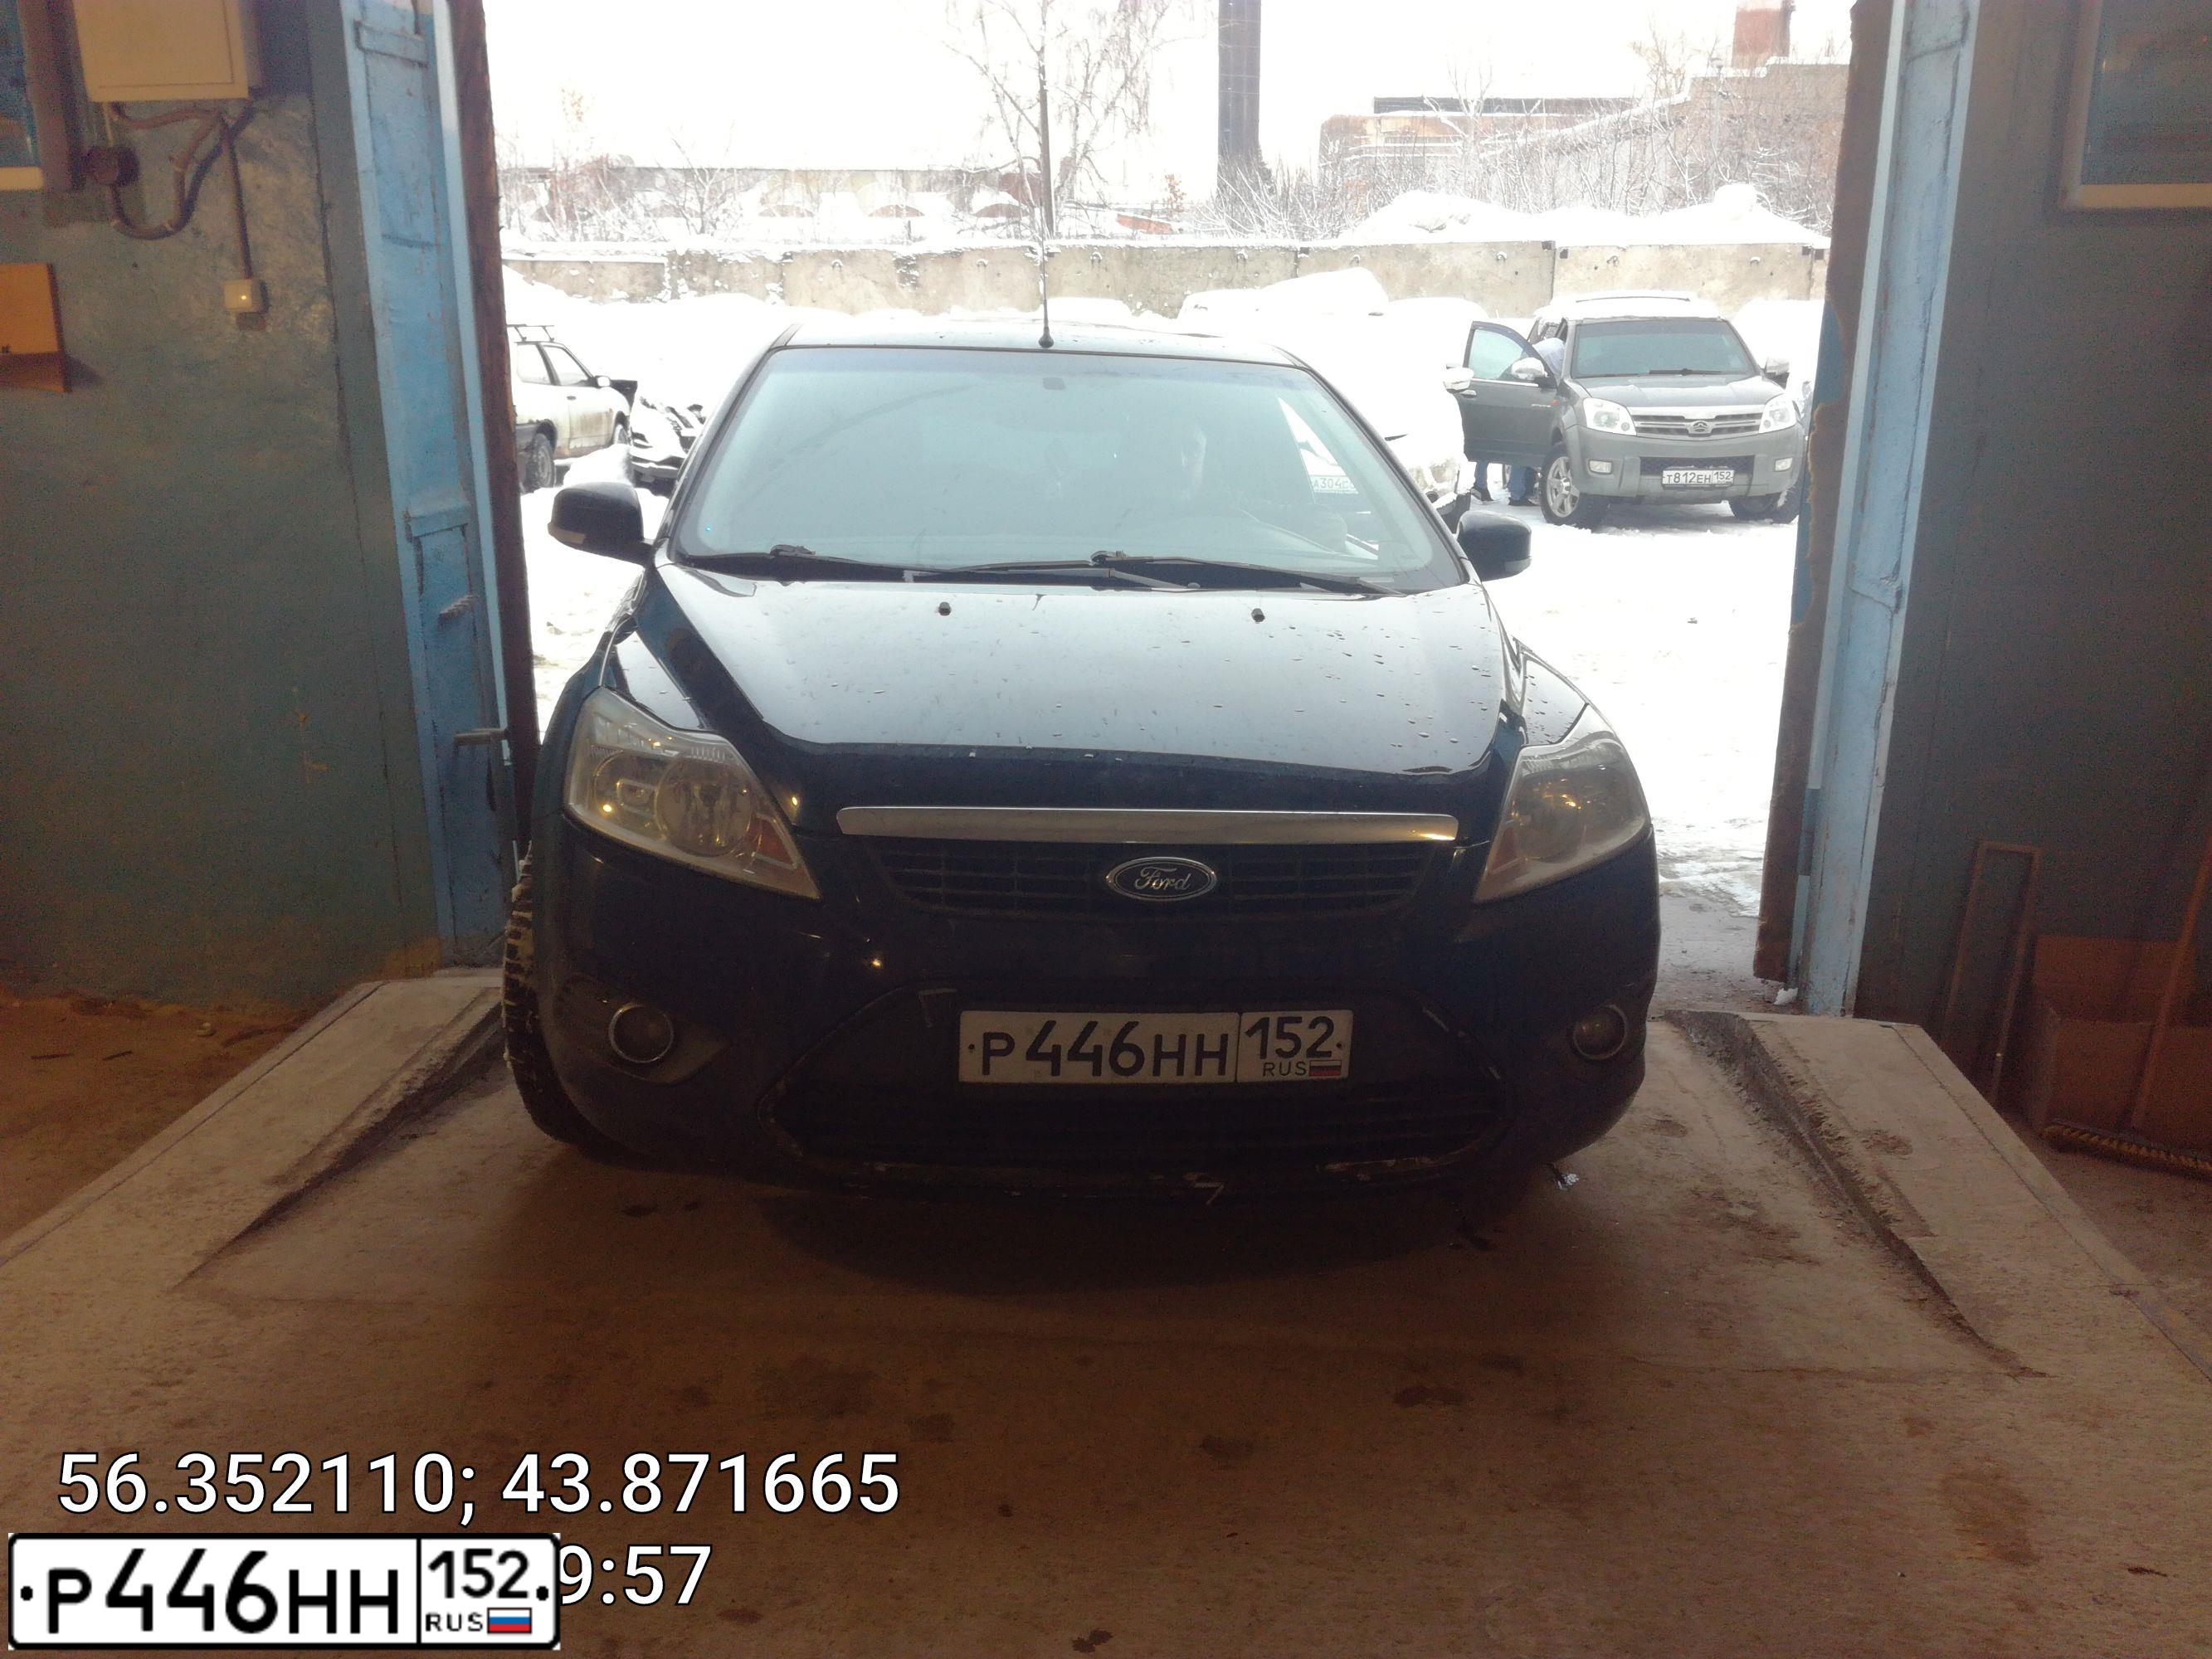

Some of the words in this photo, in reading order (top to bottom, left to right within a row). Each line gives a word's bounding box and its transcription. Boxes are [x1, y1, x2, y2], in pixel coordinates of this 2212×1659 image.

[1713, 471, 1732, 480] 152
[1134, 866, 1192, 891] Ford
[982, 1019, 1229, 1078] Р446НН
[1244, 1015, 1335, 1060] 152
[1262, 1062, 1308, 1078] RUS
